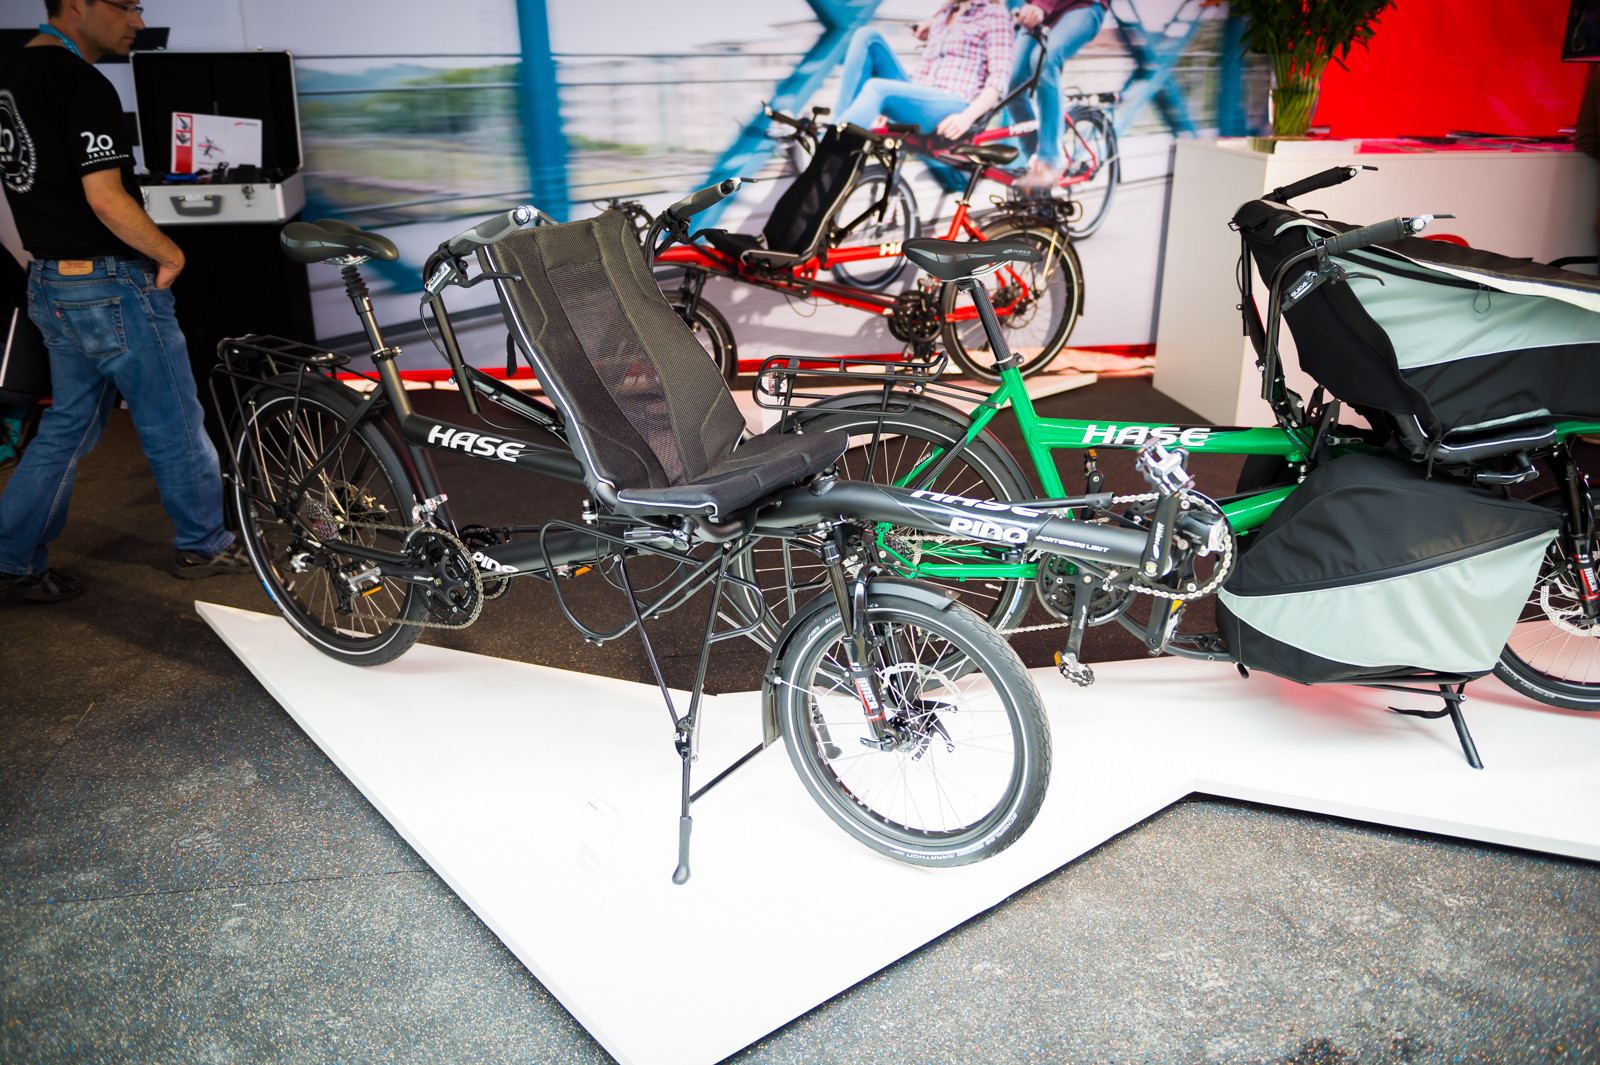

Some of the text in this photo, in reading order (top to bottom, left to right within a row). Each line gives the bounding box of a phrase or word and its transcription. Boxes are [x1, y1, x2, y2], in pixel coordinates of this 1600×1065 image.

[80, 131, 114, 153] 20
[427, 424, 527, 463] HASE
[1081, 424, 1211, 447] HASE
[949, 516, 1029, 544] PINO
[1086, 543, 1110, 553] LIMIT
[472, 550, 520, 573] PINO
